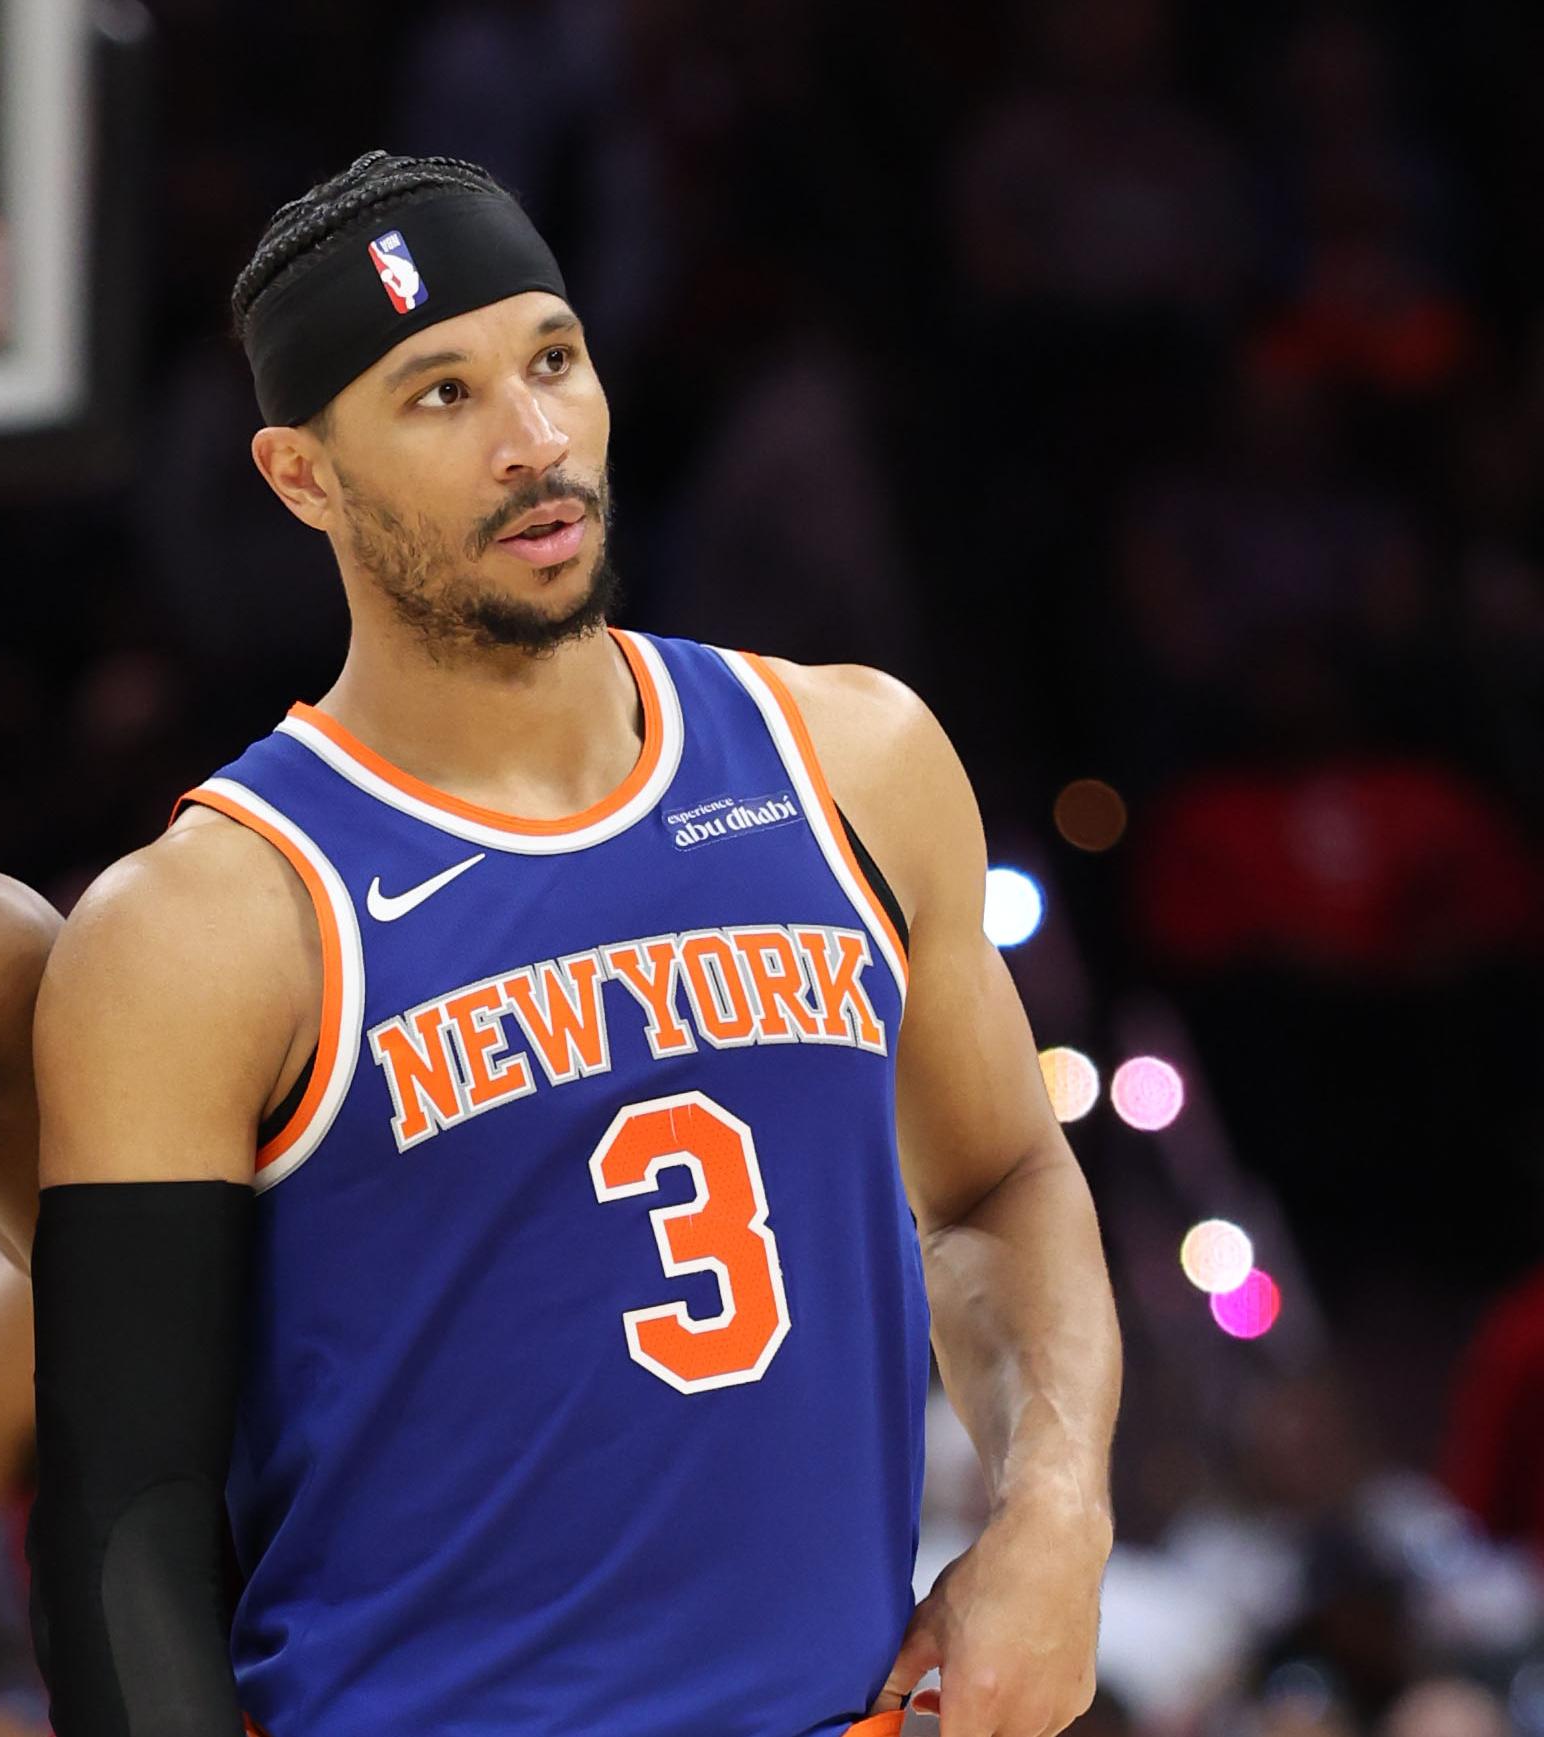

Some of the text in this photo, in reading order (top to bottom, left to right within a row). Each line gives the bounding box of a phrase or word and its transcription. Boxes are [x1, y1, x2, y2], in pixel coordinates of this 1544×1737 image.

[667, 797, 734, 824] experience
[675, 795, 798, 847] abu dhabi
[368, 924, 888, 1154] NEW YORK
[588, 1090, 791, 1395] 3
